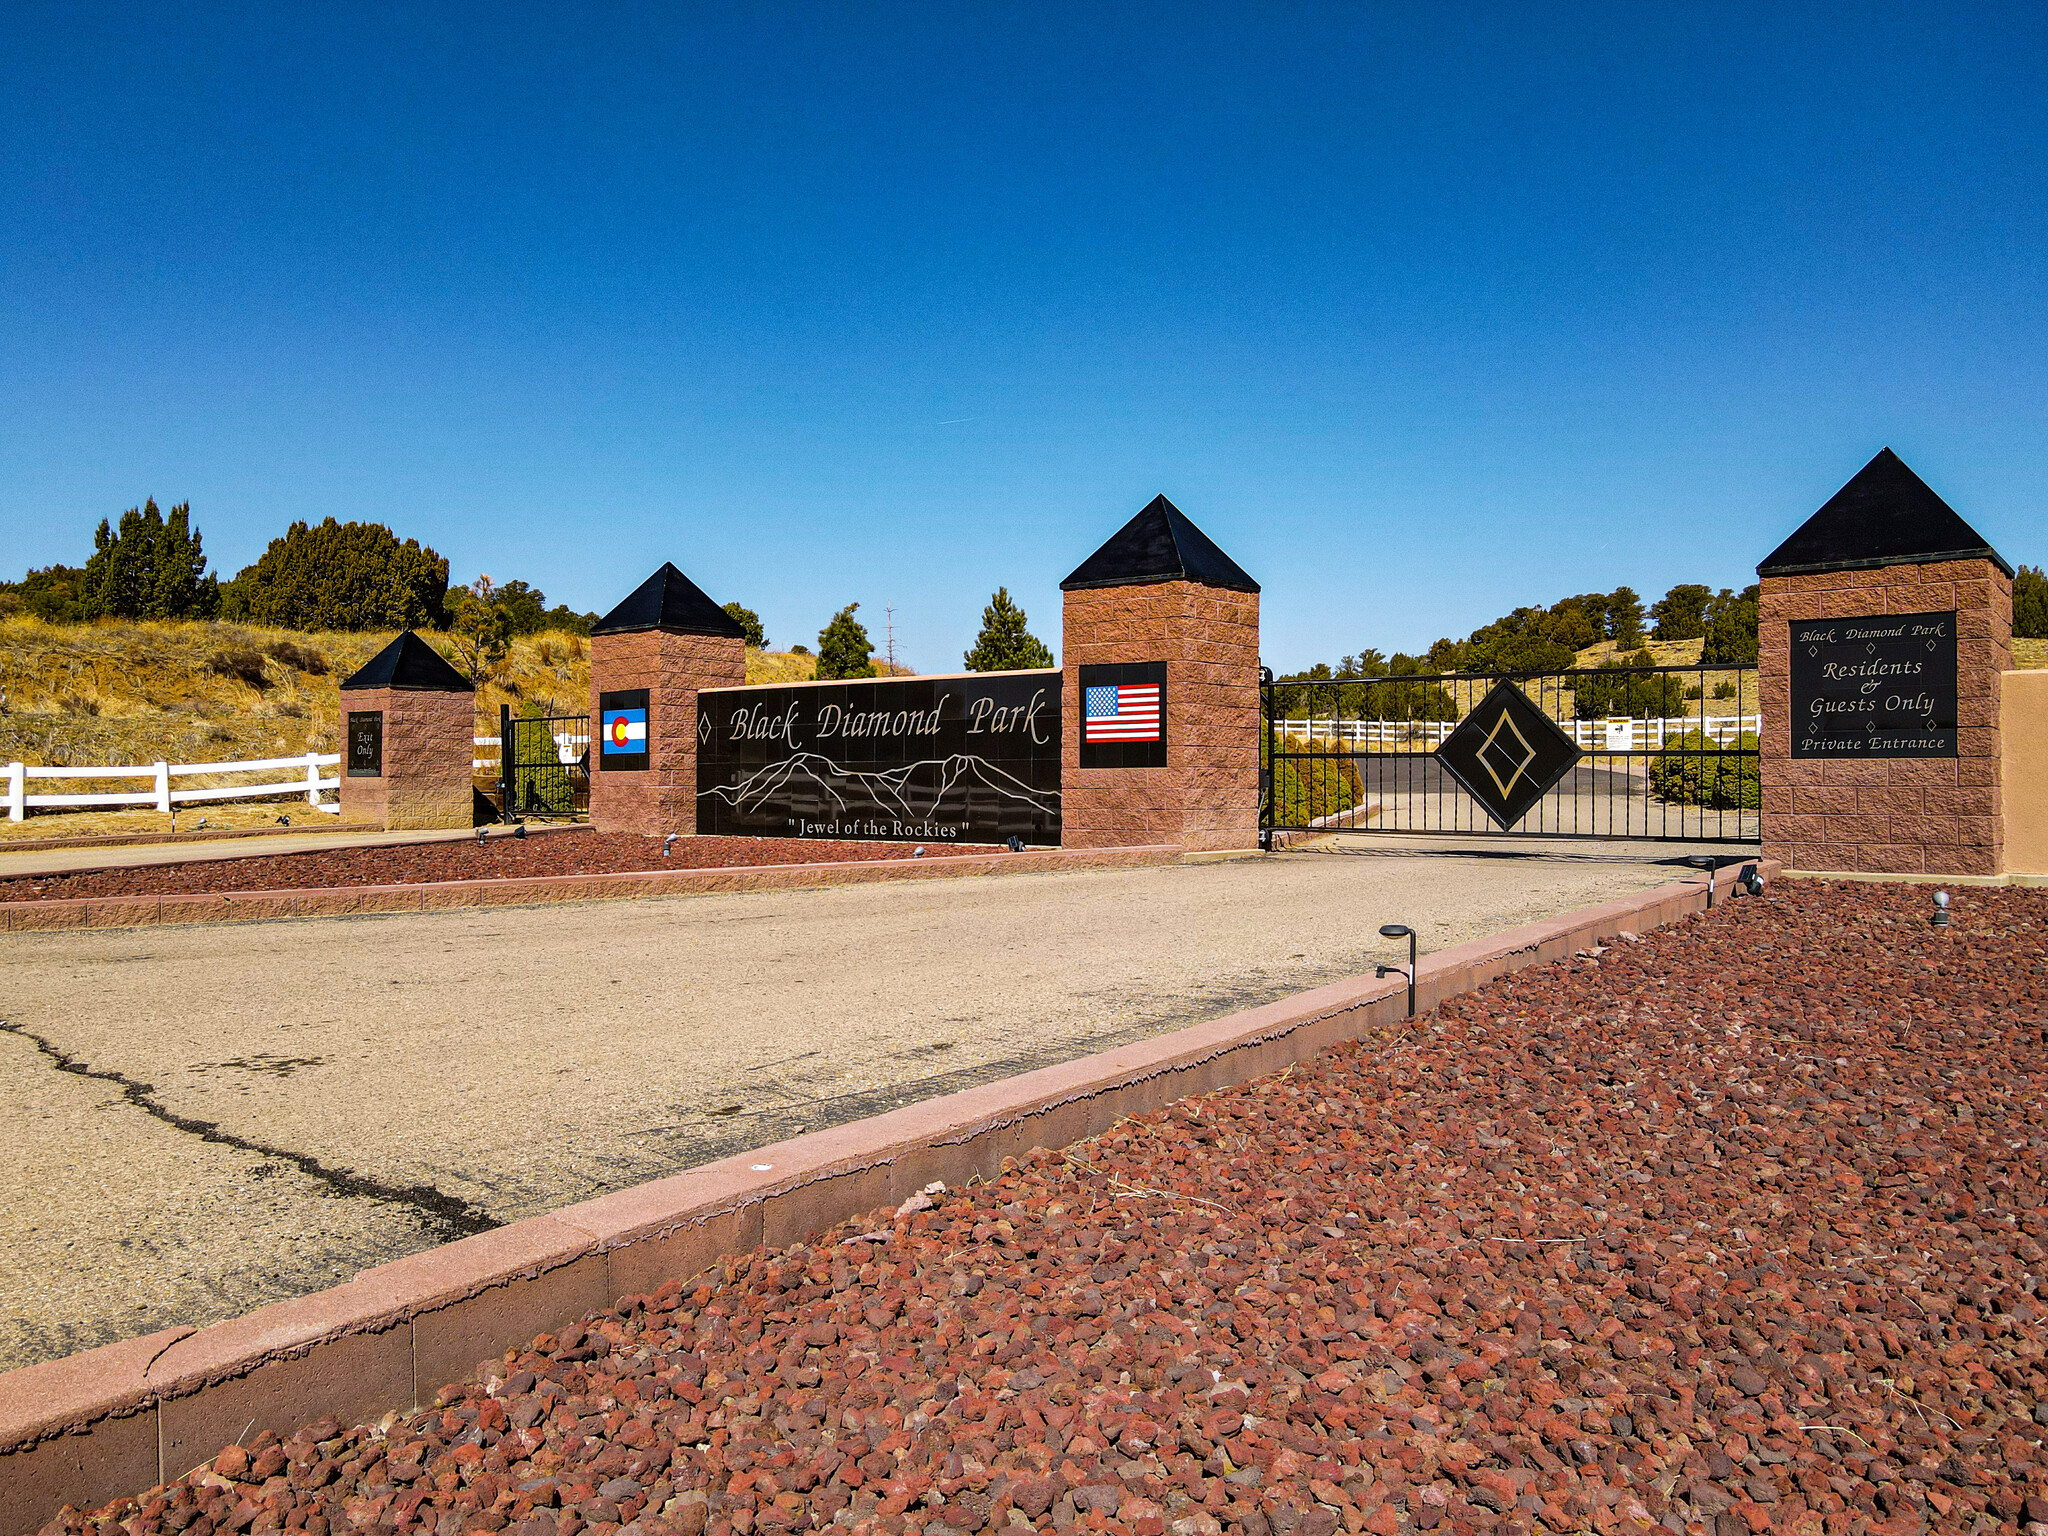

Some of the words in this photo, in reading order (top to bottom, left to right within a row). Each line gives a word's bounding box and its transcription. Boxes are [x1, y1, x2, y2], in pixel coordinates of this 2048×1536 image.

[1799, 629, 1837, 643] Black
[1845, 624, 1906, 640] Diamond
[1911, 622, 1946, 638] Park
[1823, 658, 1923, 681] Residents
[1860, 679, 1882, 694] &
[1810, 698, 1876, 718] Guests
[1885, 692, 1935, 717] Only
[729, 700, 802, 750] Black
[816, 693, 950, 738] Diamond
[966, 688, 1050, 745] Park
[357, 731, 373, 744] Exit
[1801, 738, 1861, 751] Private
[1868, 737, 1945, 749] Entrance
[356, 744, 374, 759] Only
[844, 819, 861, 835] of
[863, 820, 888, 835] the
